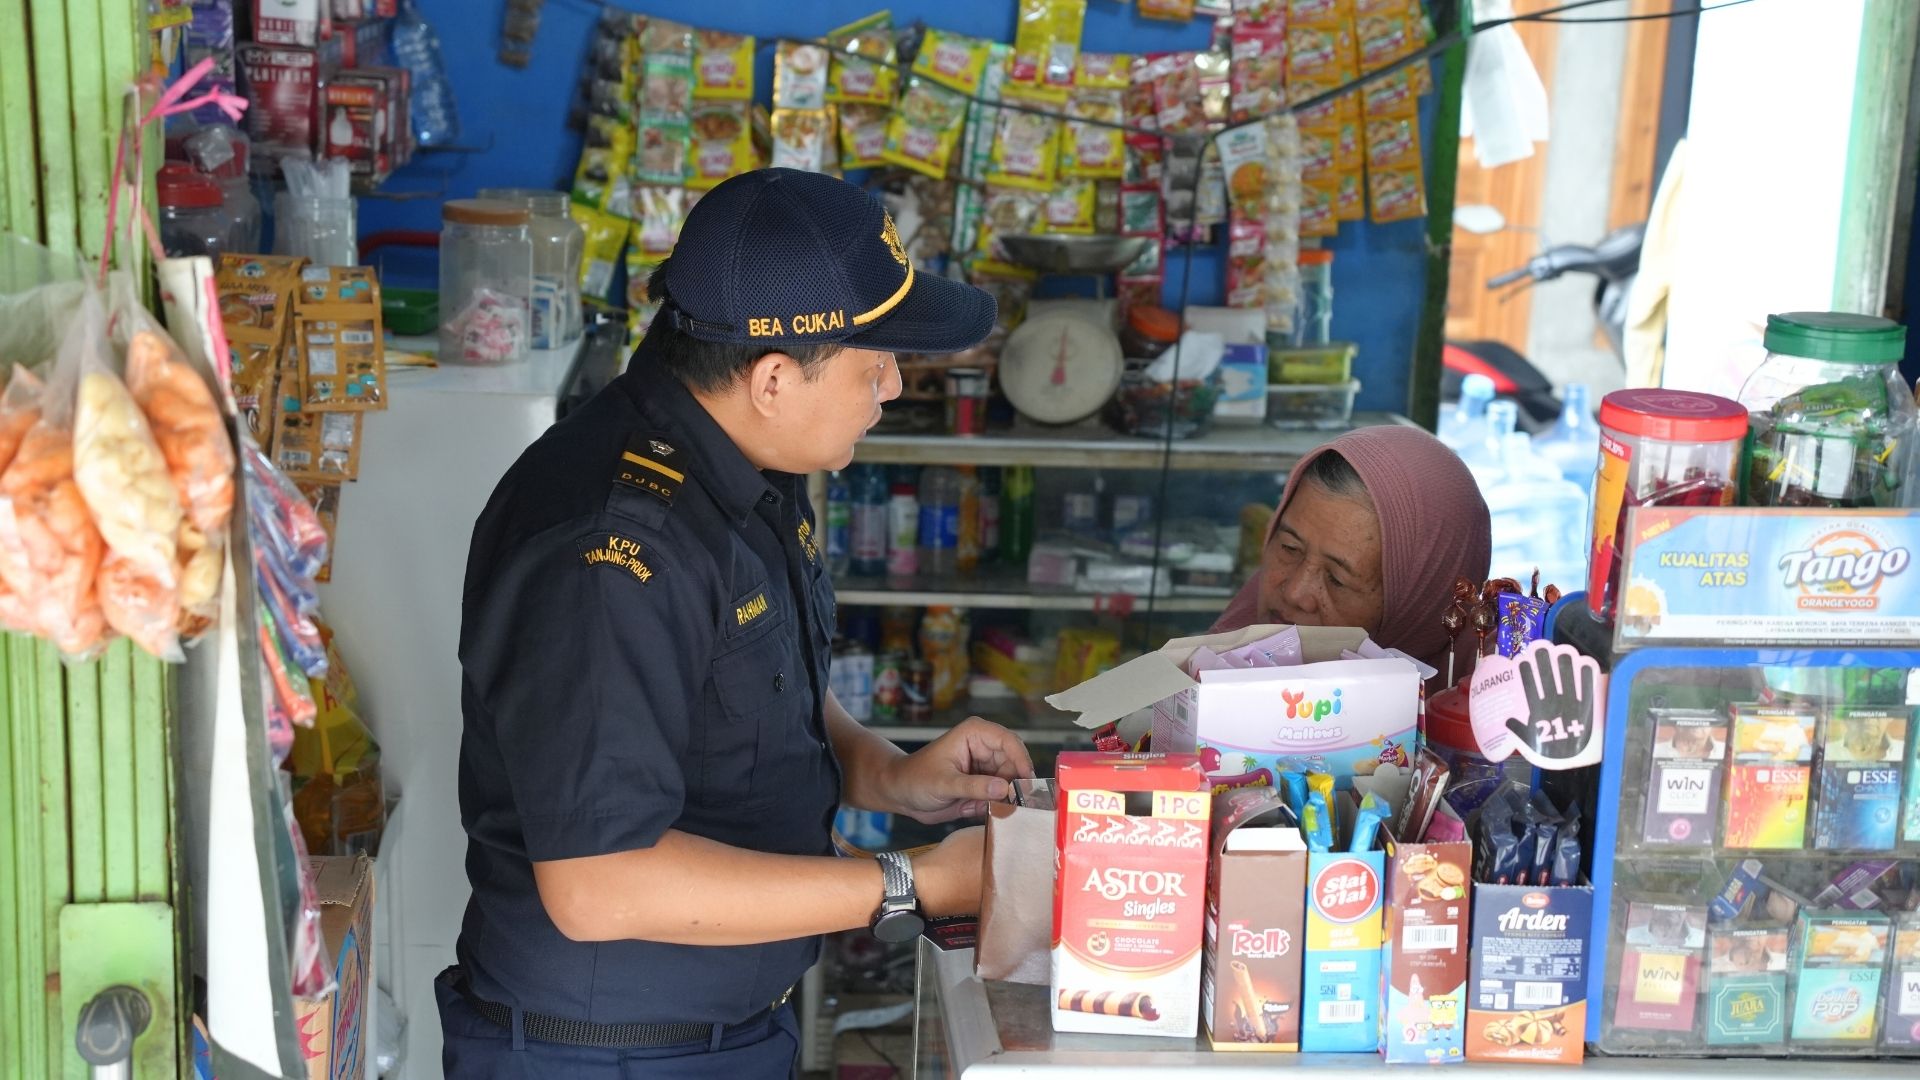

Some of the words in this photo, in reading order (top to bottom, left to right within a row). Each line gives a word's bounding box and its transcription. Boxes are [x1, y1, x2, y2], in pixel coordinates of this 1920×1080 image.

[749, 316, 784, 337] BEA
[792, 309, 845, 335] CUKAI
[1641, 519, 1671, 541] NEW
[609, 535, 641, 556] KPU
[1660, 552, 1750, 568] KUALITAS
[1778, 546, 1911, 590] Tango
[1699, 571, 1748, 587] ATAS
[736, 592, 769, 626] RAHMAN
[1801, 598, 1873, 609] ORANGEYOGO
[1472, 669, 1514, 699] DILARANG!
[1281, 688, 1343, 722] Yupi
[1849, 711, 1888, 719] PERINGATAN
[1279, 726, 1342, 739] Mallows
[1535, 716, 1585, 743] 21+
[1123, 752, 1166, 760] Singles
[1771, 770, 1805, 783] ESSE
[1863, 770, 1897, 784] ESSE
[1173, 797, 1201, 815] PC
[1082, 868, 1187, 900] ASTOR
[1123, 900, 1175, 920] Singles
[1498, 907, 1567, 932] Arden
[1114, 936, 1160, 945] CHOCOLATE
[1320, 985, 1337, 996] SNI
[1730, 1000, 1764, 1017] JUARA
[1812, 1002, 1859, 1017] POP
